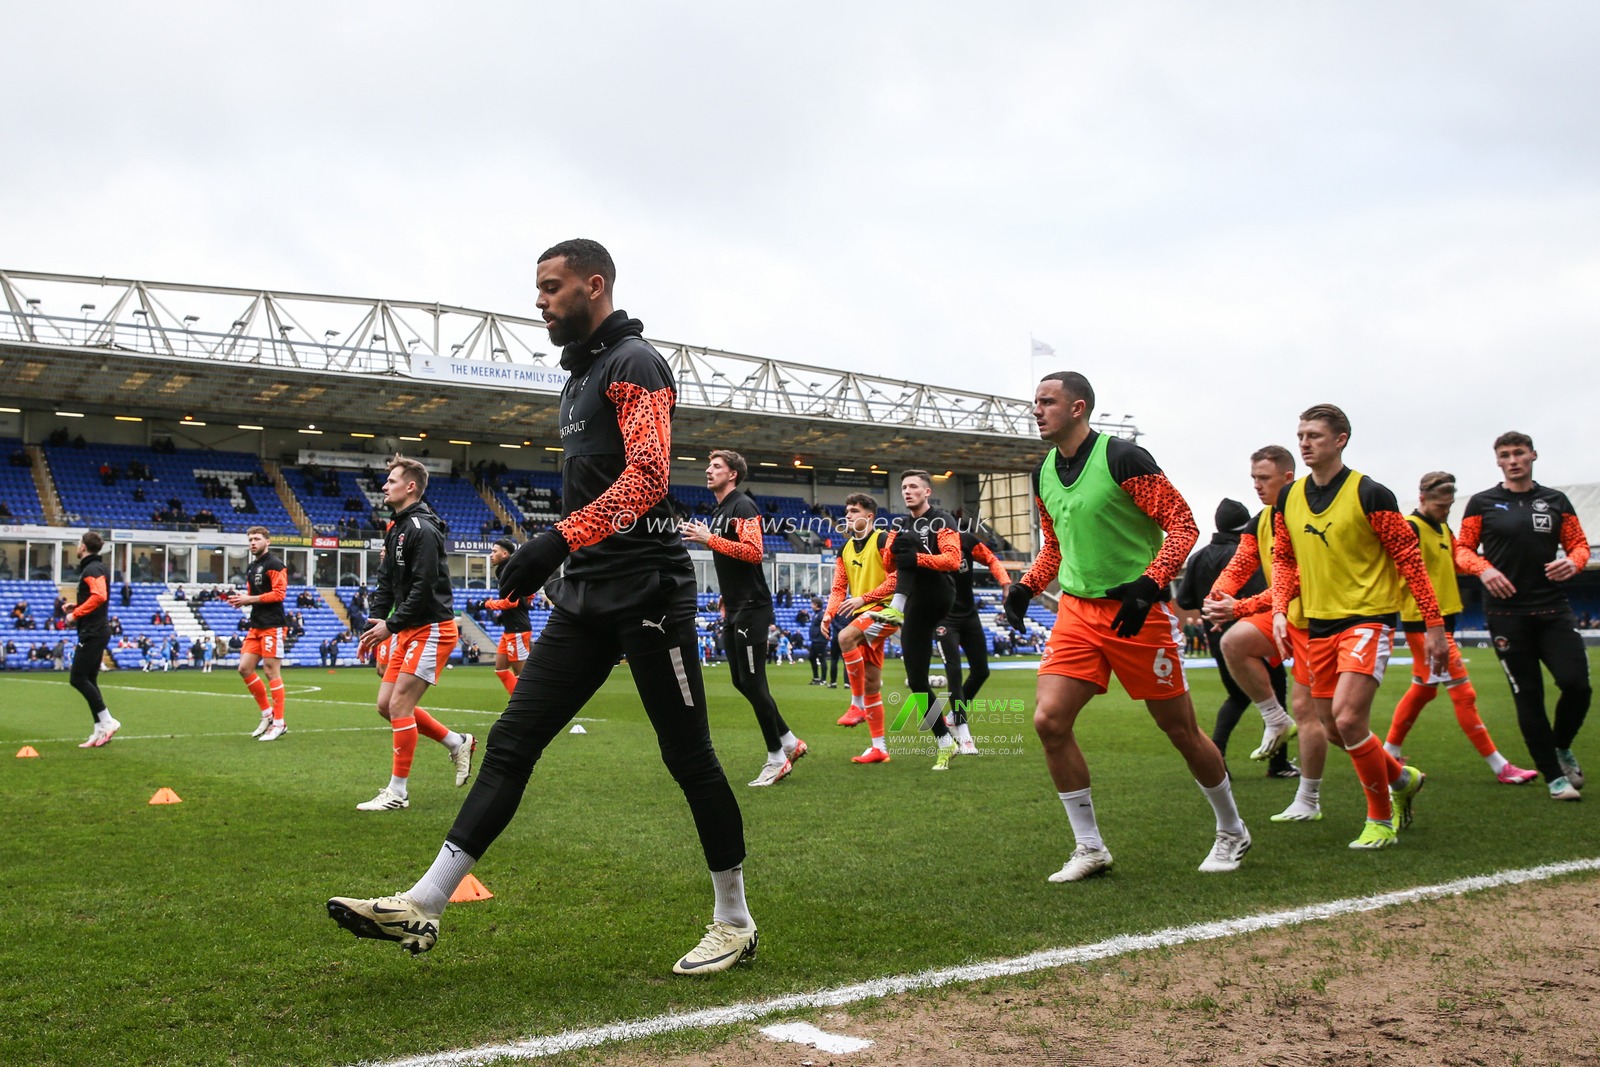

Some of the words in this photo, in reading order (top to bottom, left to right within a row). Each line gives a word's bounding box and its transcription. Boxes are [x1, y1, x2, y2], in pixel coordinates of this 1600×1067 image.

[451, 364, 468, 375] THE
[471, 366, 511, 379] MEERKAT
[515, 370, 545, 382] FAMILY
[547, 374, 570, 386] STAN
[454, 541, 494, 550] BADRHIN
[265, 636, 273, 649] 5
[1353, 628, 1374, 652] 7
[380, 644, 387, 656] 8
[1153, 648, 1173, 677] 6
